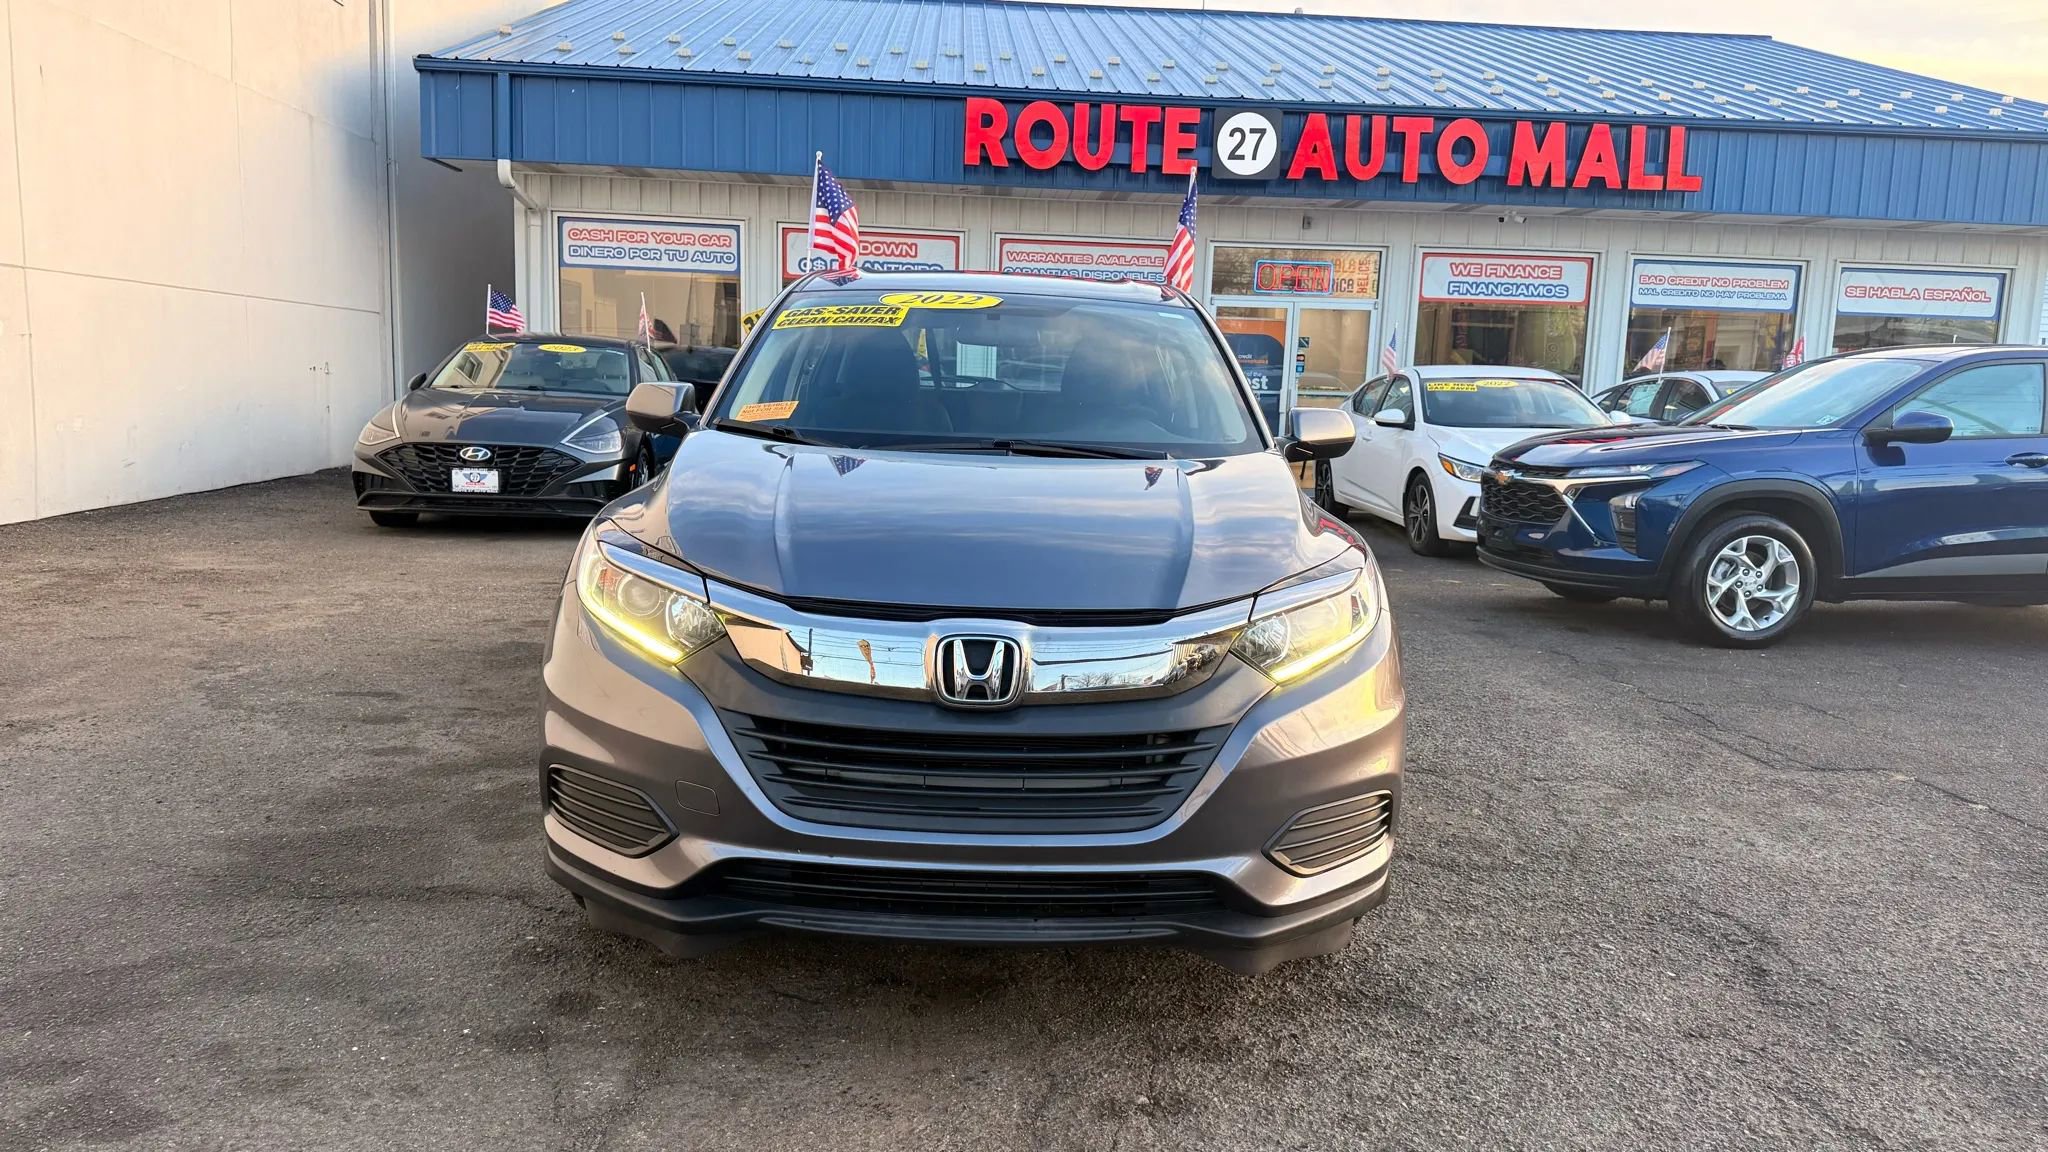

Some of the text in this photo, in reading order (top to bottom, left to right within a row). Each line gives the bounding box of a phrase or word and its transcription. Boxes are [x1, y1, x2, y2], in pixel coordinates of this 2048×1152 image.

[964, 97, 1702, 192] ROUTE 27 AUTO MALL
[569, 228, 732, 248] CASH FOR YOUR CAR
[569, 245, 736, 264] DINERO POR TU AUTO
[858, 240, 918, 258] DOWN
[1006, 250, 1165, 268] WARRANTIES AVAILABLE
[1079, 269, 1166, 283] DISPONIBLES
[1258, 264, 1331, 292] OPEN
[1450, 263, 1563, 280] WE FINANCE
[1448, 280, 1569, 297] FINANCIAMOS
[1639, 275, 1789, 290] BAD CREDIT NO PROBLEM
[897, 294, 983, 305] 2022
[1638, 288, 1787, 301] MAL CREDITO NO HAY PROBLEMA
[1845, 286, 1991, 303] SE HABLA ESPAÑOL
[784, 306, 901, 318] GAS-SAVER
[777, 316, 900, 327] CLEAN CARFAX
